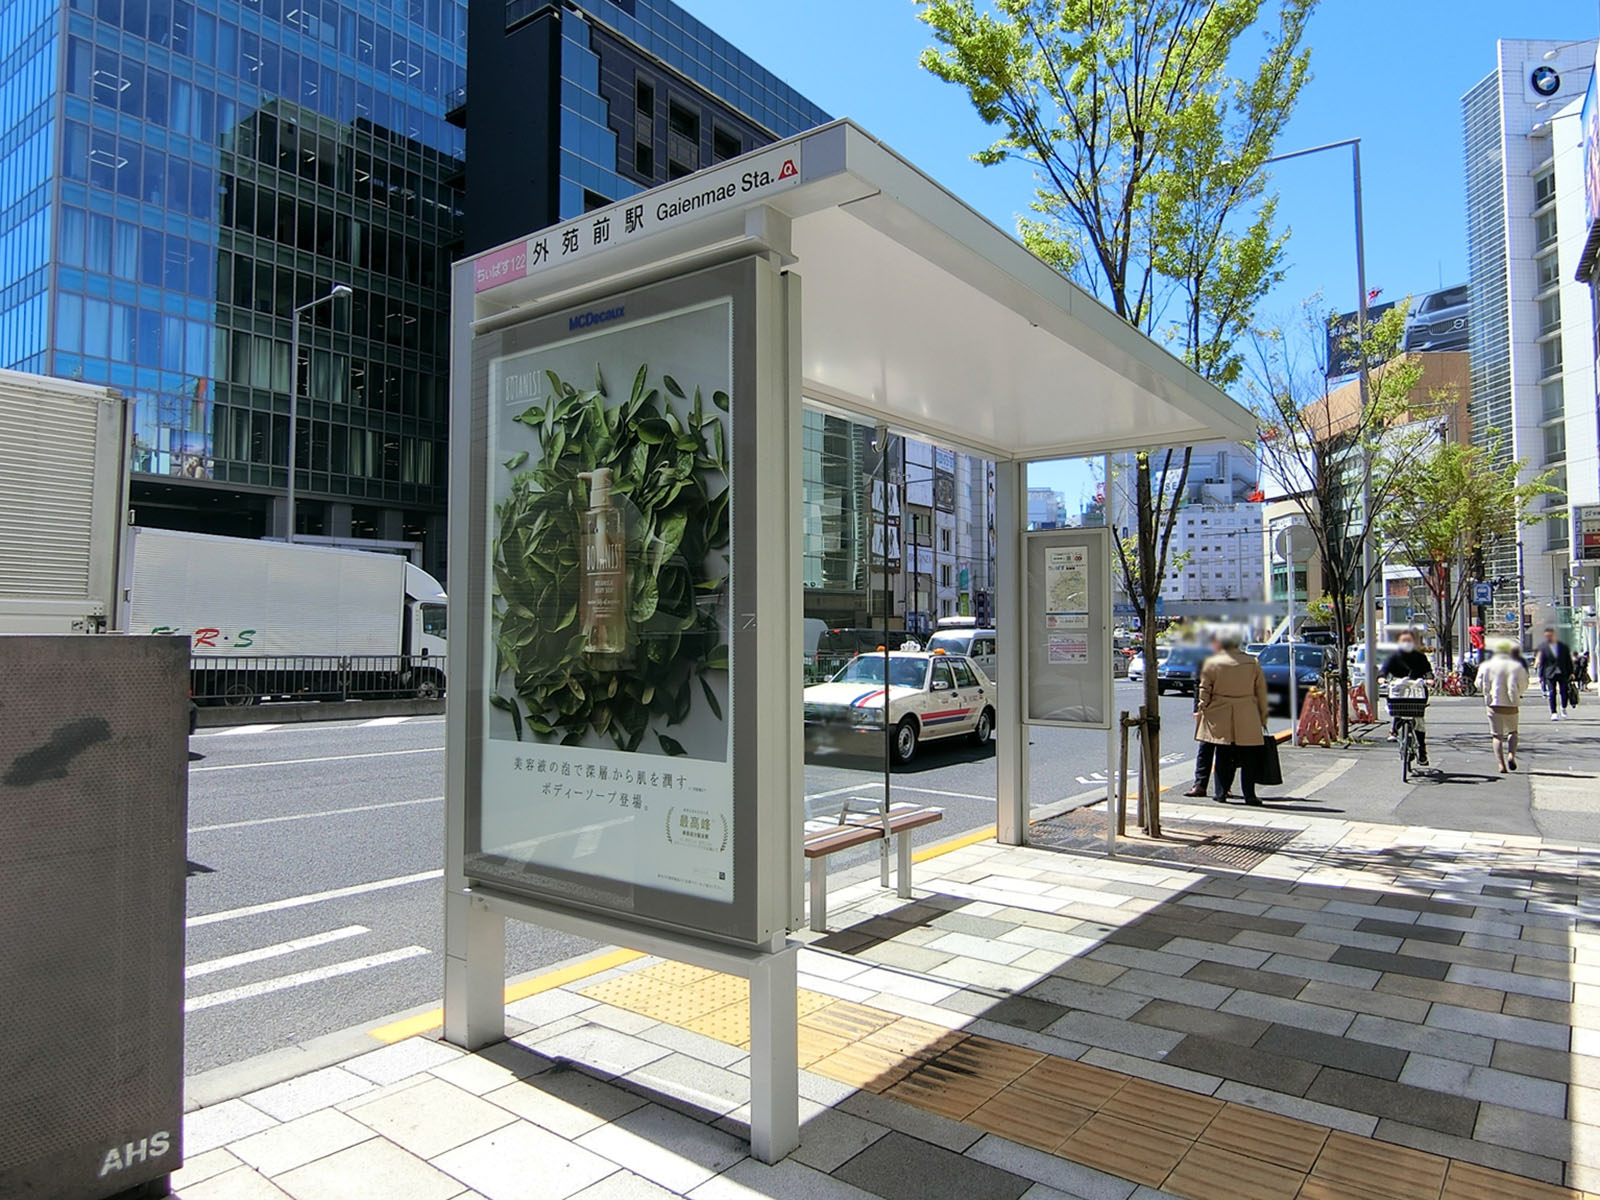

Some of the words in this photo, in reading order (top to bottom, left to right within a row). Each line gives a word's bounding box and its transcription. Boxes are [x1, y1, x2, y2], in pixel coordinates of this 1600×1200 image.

[656, 183, 736, 221] Gaienmae
[741, 170, 775, 192] Sta.
[533, 204, 644, 266] 外苑前駅
[511, 253, 526, 272] 122
[568, 305, 625, 331] MCDecaux
[513, 756, 687, 790] 美容液の泡で深層から肌を潤す
[541, 782, 649, 811] ボディーソープ登場。
[100, 1130, 170, 1177] AHS
